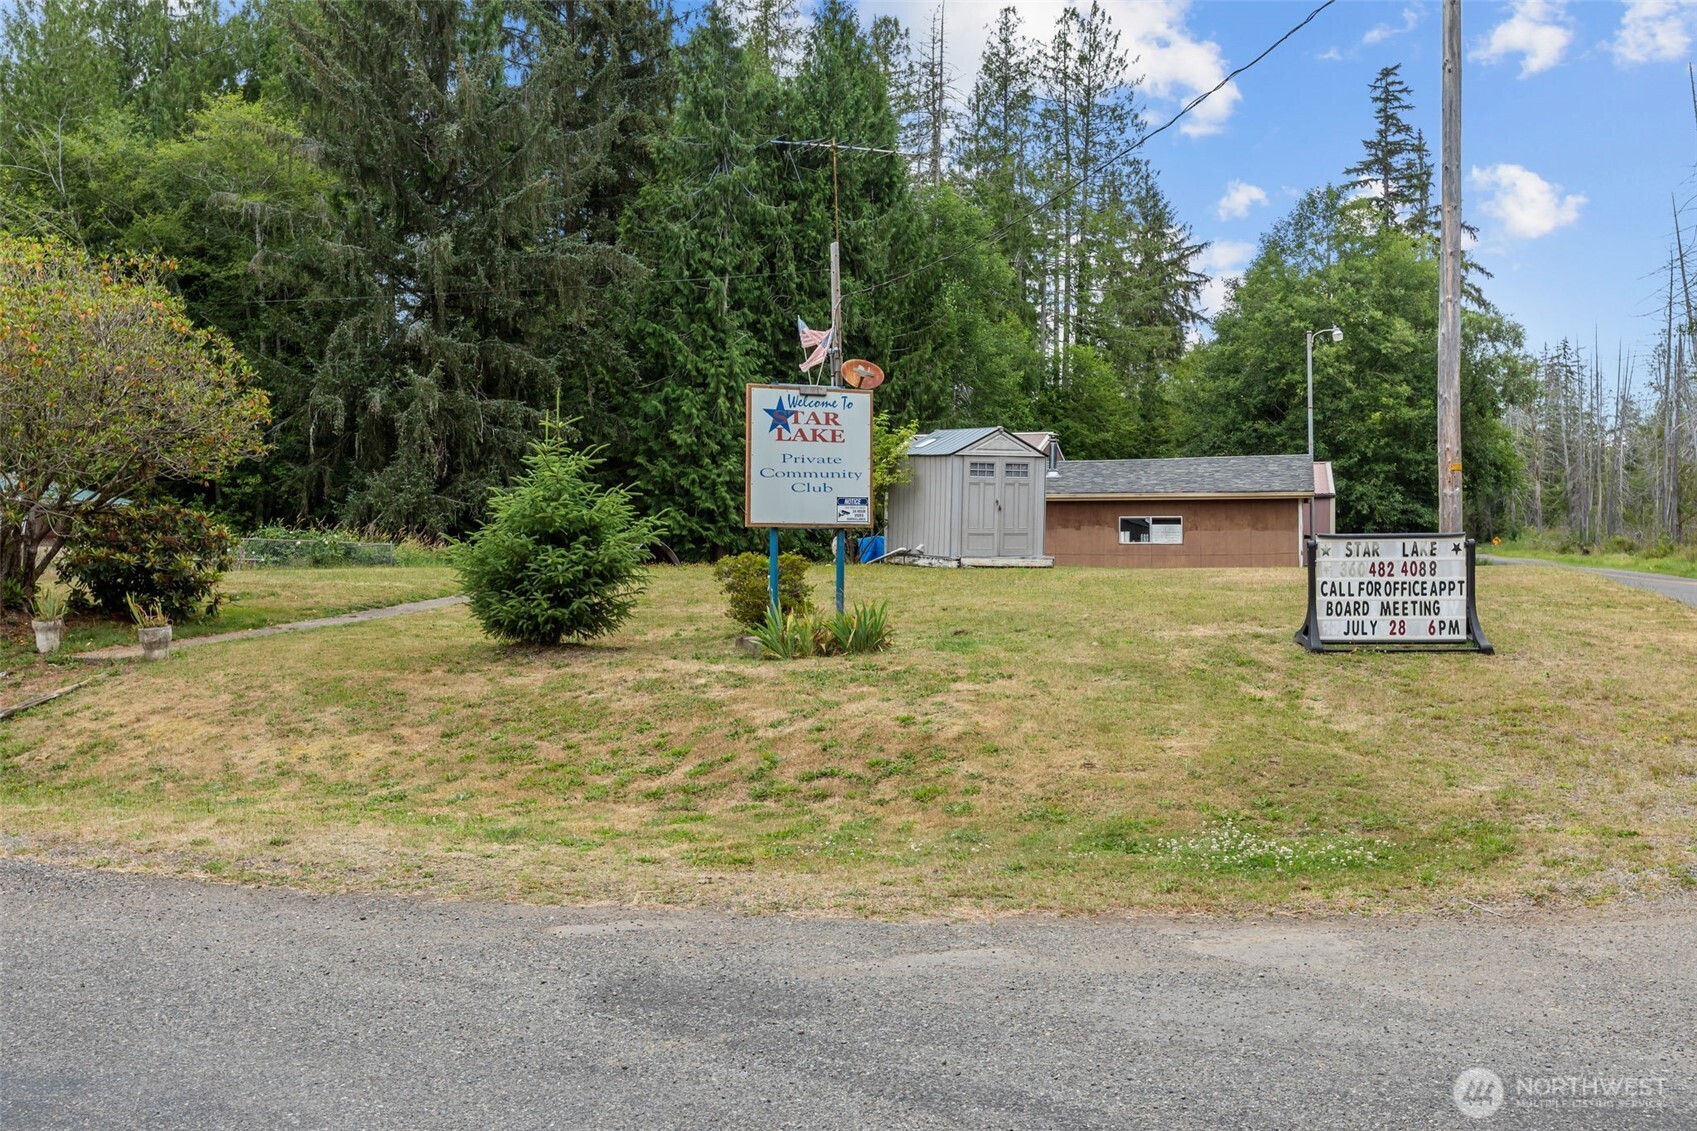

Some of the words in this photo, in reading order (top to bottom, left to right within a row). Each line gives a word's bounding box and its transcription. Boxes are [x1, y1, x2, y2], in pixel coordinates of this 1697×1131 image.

[788, 394, 838, 408] Welcome
[841, 396, 854, 410] To
[773, 410, 842, 426] STAR
[776, 428, 846, 443] LAKE
[782, 454, 842, 464] Private
[760, 468, 862, 480] Community
[791, 482, 833, 492] Club
[1345, 542, 1380, 558] STAR
[1402, 542, 1437, 558] LAKE
[1340, 562, 1365, 577] 360
[1369, 561, 1395, 577] 482
[1401, 560, 1437, 577] 4088
[1320, 581, 1354, 597] CALL
[1358, 581, 1382, 596] FOR
[1385, 581, 1427, 596] OFFICE
[1430, 580, 1465, 596] APPT
[1326, 601, 1370, 616] BOARD
[1380, 600, 1440, 616] MEETING
[1343, 620, 1378, 636] JULY
[1389, 620, 1406, 635] 28
